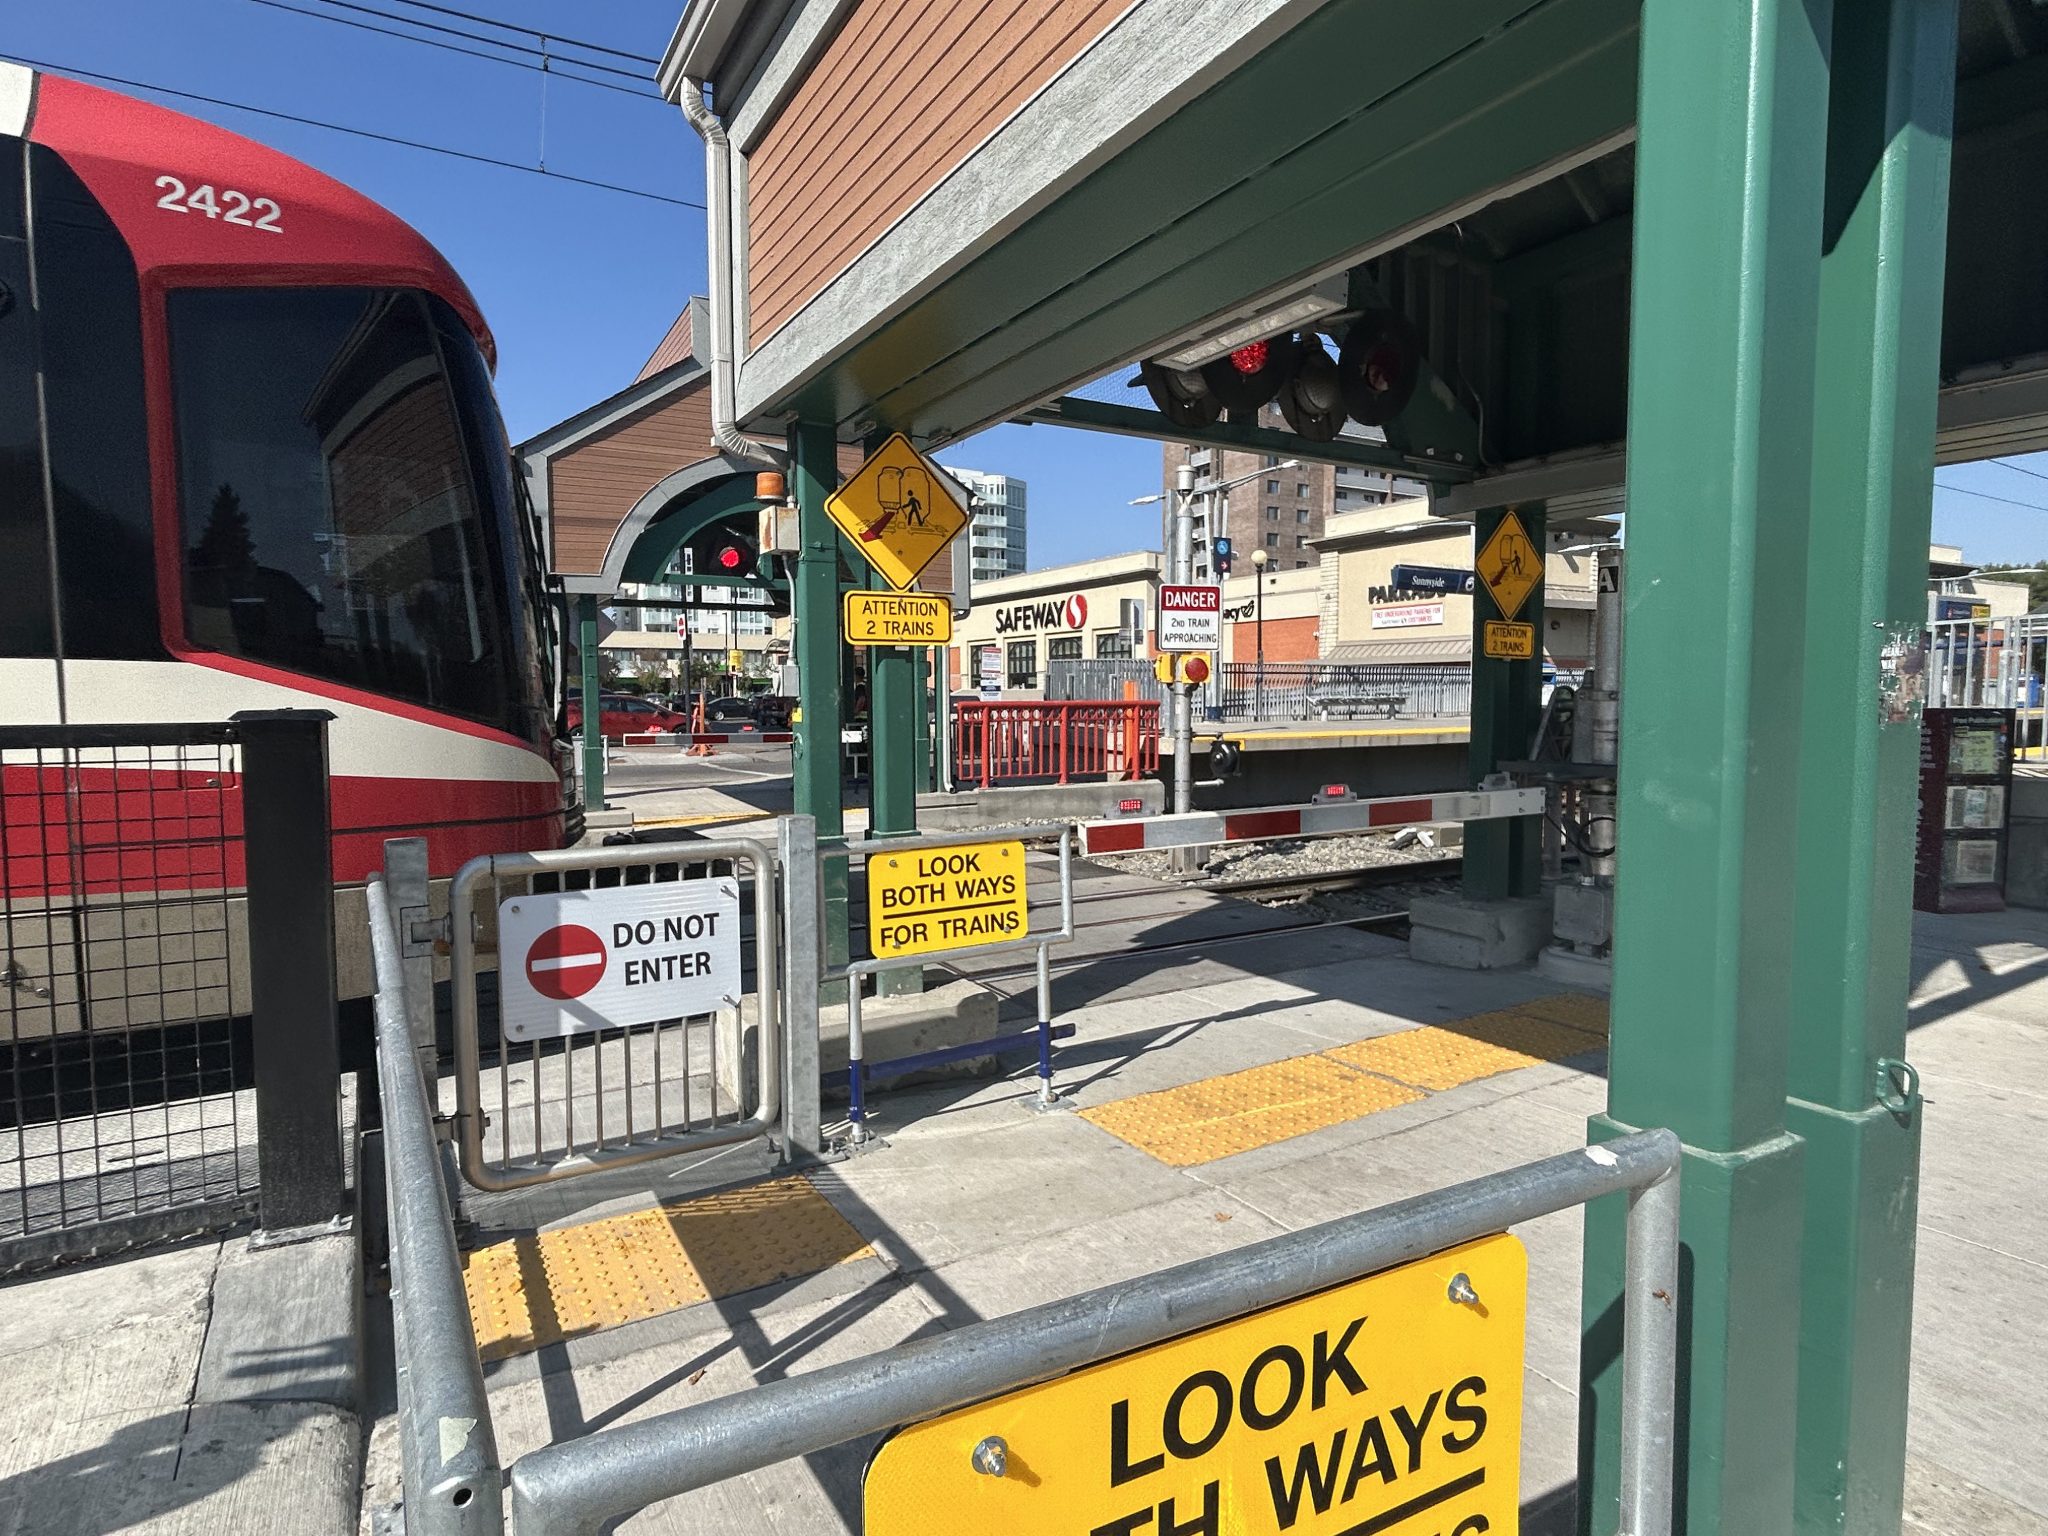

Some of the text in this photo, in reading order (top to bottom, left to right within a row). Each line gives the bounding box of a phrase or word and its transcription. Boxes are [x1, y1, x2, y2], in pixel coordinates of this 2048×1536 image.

[155, 175, 284, 234] 2422
[1412, 575, 1445, 589] Sunnyside
[1599, 567, 1616, 592] A
[862, 600, 938, 617] ATTENTION
[1165, 591, 1216, 608] DANGER
[867, 620, 934, 636] 2 TRAINS
[996, 600, 1066, 634] SAFEWAY
[1171, 617, 1210, 628] 2ND TRAIN
[1164, 633, 1217, 643] APPROACHING
[1491, 626, 1528, 639] ATTENTION
[1492, 641, 1525, 653] 2 TRAINS
[918, 853, 981, 878] LOOK
[882, 874, 1016, 908] BOTH WAYS
[613, 912, 720, 948] DO NOT
[881, 910, 1020, 947] FOR TRAINS
[625, 951, 712, 986] ENTER
[1111, 1316, 1369, 1488] LOOK
[1264, 1375, 1488, 1531] WAYS
